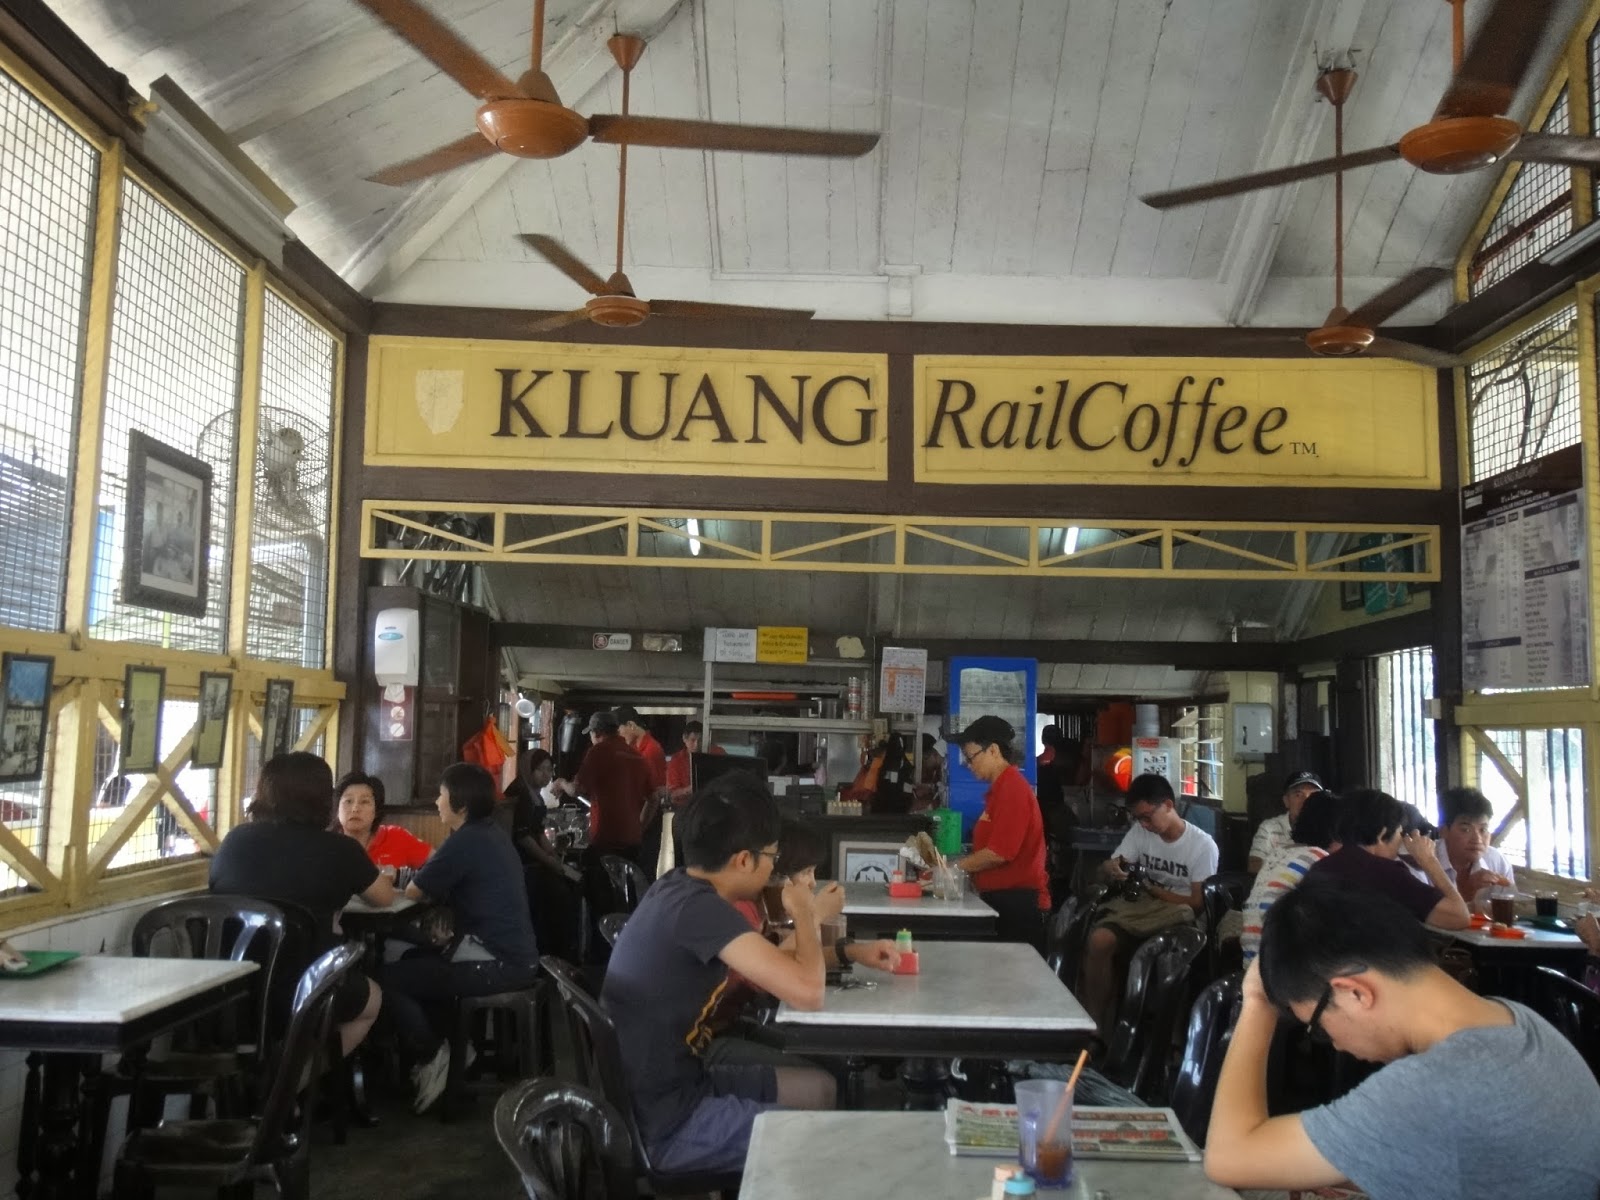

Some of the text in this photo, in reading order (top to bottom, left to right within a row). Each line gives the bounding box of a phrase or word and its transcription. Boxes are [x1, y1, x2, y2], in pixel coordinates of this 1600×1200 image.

[493, 367, 1318, 467] KLUANG RailCoffee TM
